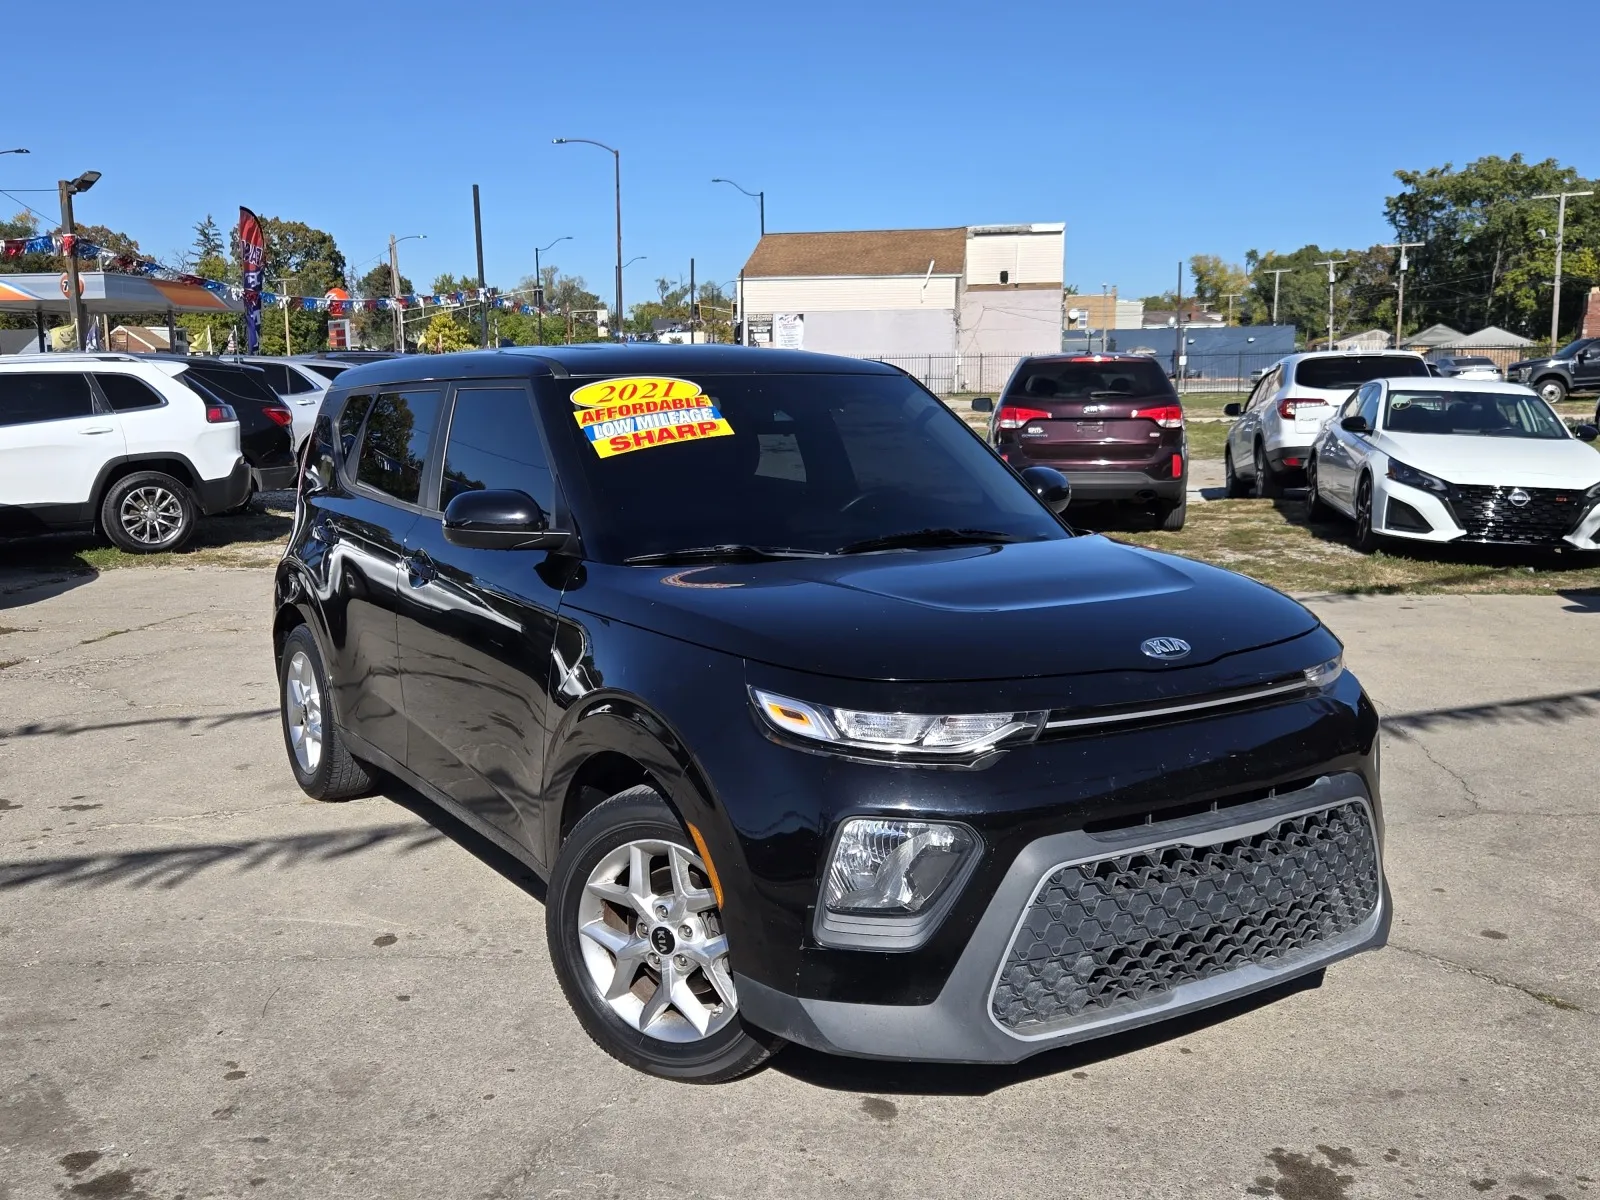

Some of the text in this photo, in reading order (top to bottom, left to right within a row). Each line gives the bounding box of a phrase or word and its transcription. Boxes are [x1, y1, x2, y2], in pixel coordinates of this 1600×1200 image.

[596, 382, 675, 403] 2021
[581, 397, 706, 424] AFFORDABLE
[594, 408, 715, 440] LOW MILEAGE
[609, 421, 720, 452] SHARP
[1147, 638, 1187, 654] KIA
[657, 930, 667, 952] KIA
